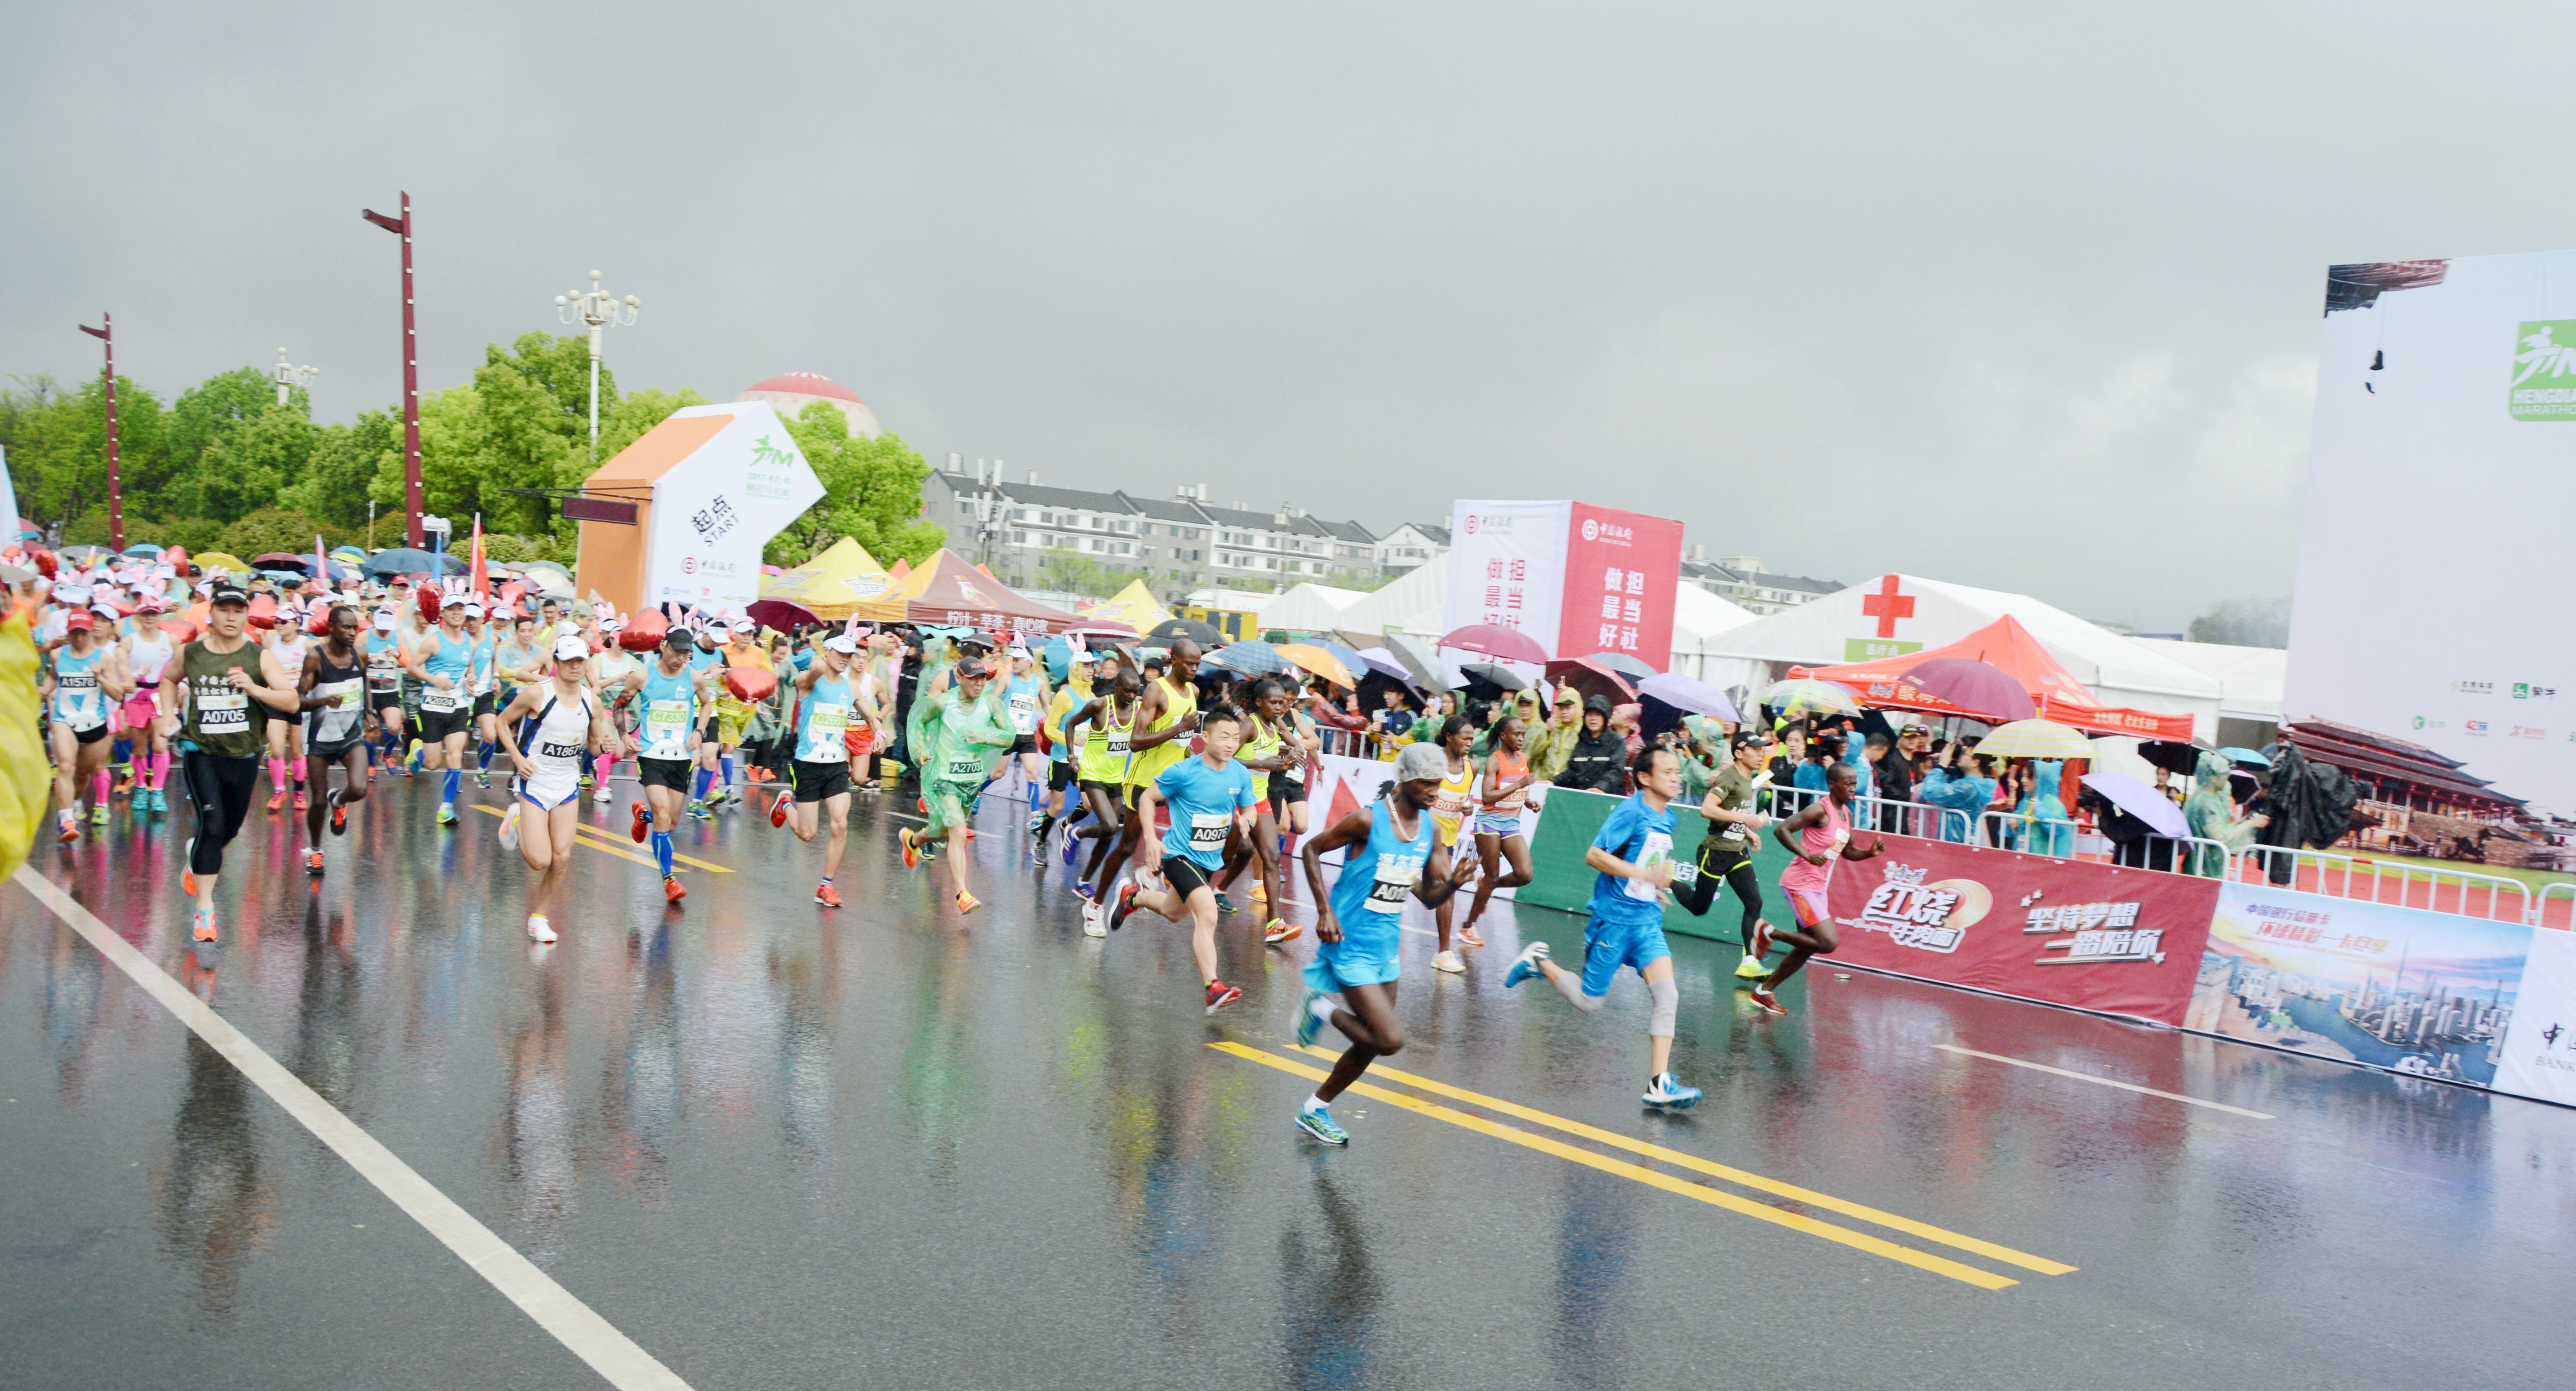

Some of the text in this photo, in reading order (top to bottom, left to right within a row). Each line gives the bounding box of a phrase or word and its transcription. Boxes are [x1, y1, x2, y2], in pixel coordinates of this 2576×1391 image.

[704, 513, 738, 547] START
[61, 677, 96, 687] A1578
[202, 709, 245, 723] A0705
[653, 710, 685, 722] C7330
[816, 715, 845, 726] C2601
[544, 744, 580, 757] A1867
[952, 763, 980, 772] A2703
[1194, 828, 1228, 840] A0976
[1865, 885, 1958, 926] 红烧
[2022, 902, 2141, 934] 坚持梦想
[1894, 922, 1958, 947] 牛肉面
[2034, 929, 2165, 965] 一路陪你
